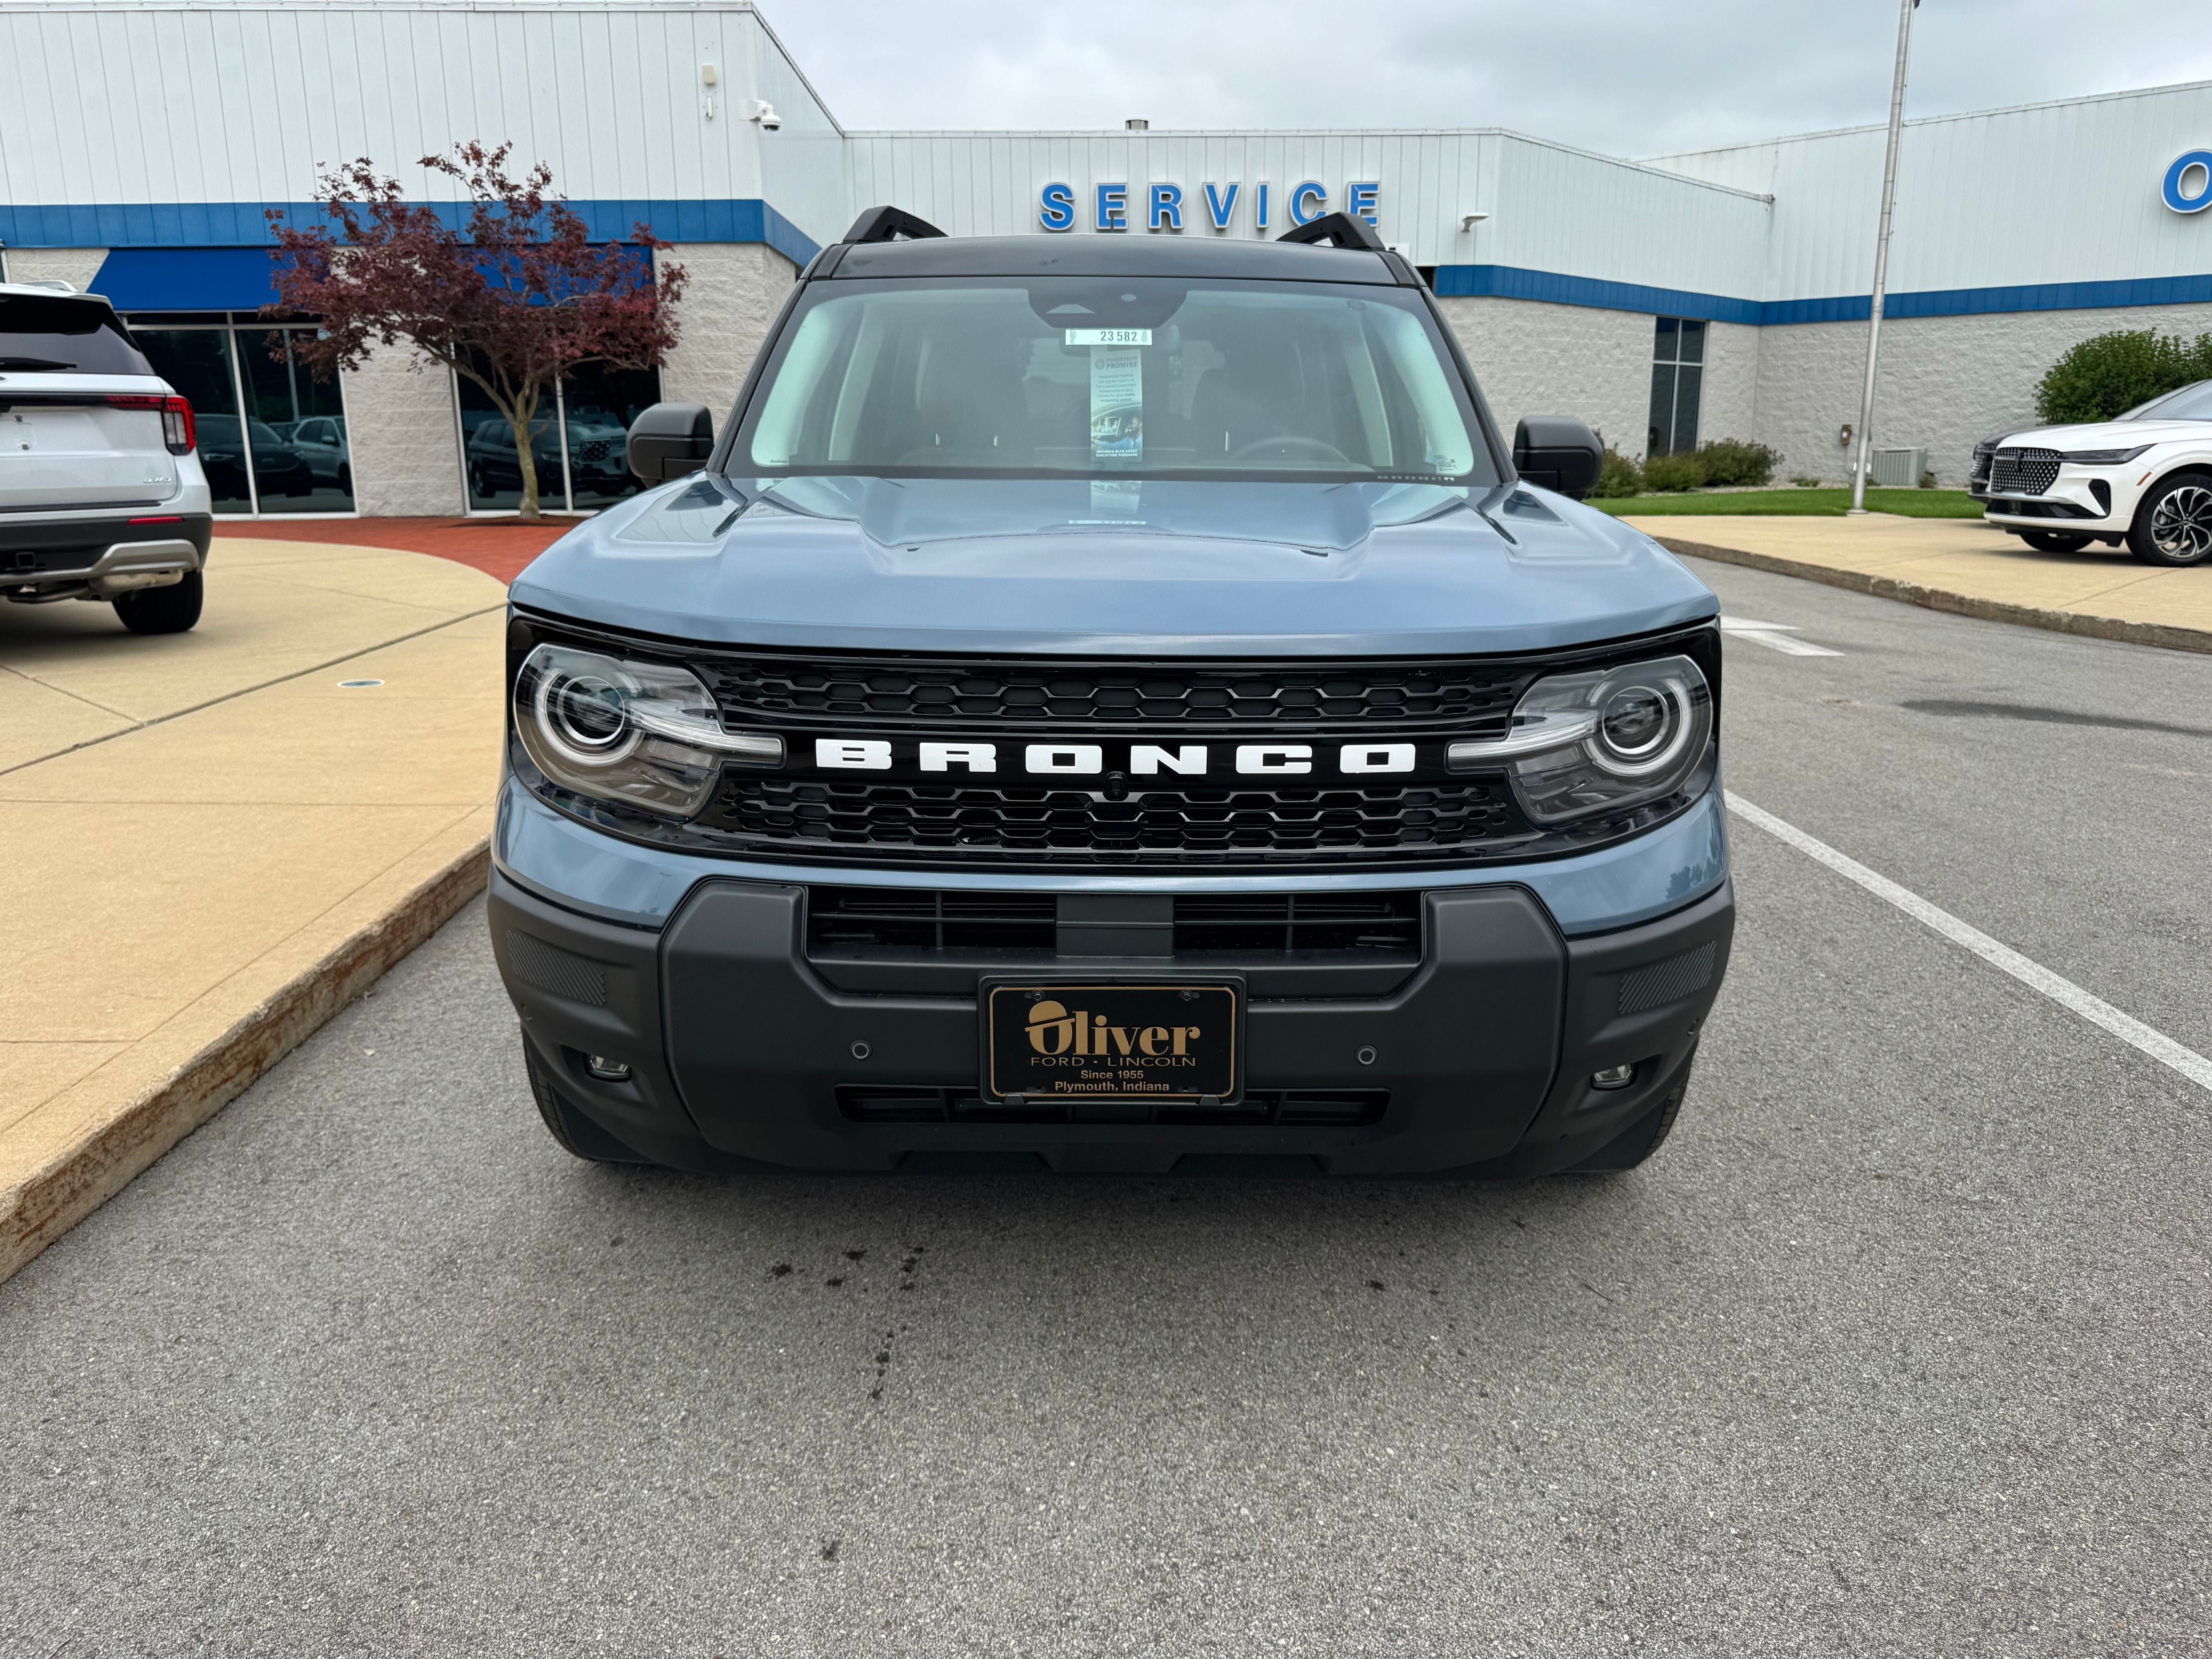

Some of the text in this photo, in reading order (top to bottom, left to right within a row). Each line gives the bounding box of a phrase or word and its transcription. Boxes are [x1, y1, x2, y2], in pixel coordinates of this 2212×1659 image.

[2161, 149, 2212, 213] O
[1039, 180, 1381, 230] SERVICE
[815, 739, 1416, 774] BRONCO
[1024, 1000, 1200, 1056] Oliver
[1031, 1057, 1196, 1067] FORD LINCOLN
[1080, 1070, 1144, 1079] Since 1955
[1055, 1081, 1170, 1093] Plymouth, Indiana
